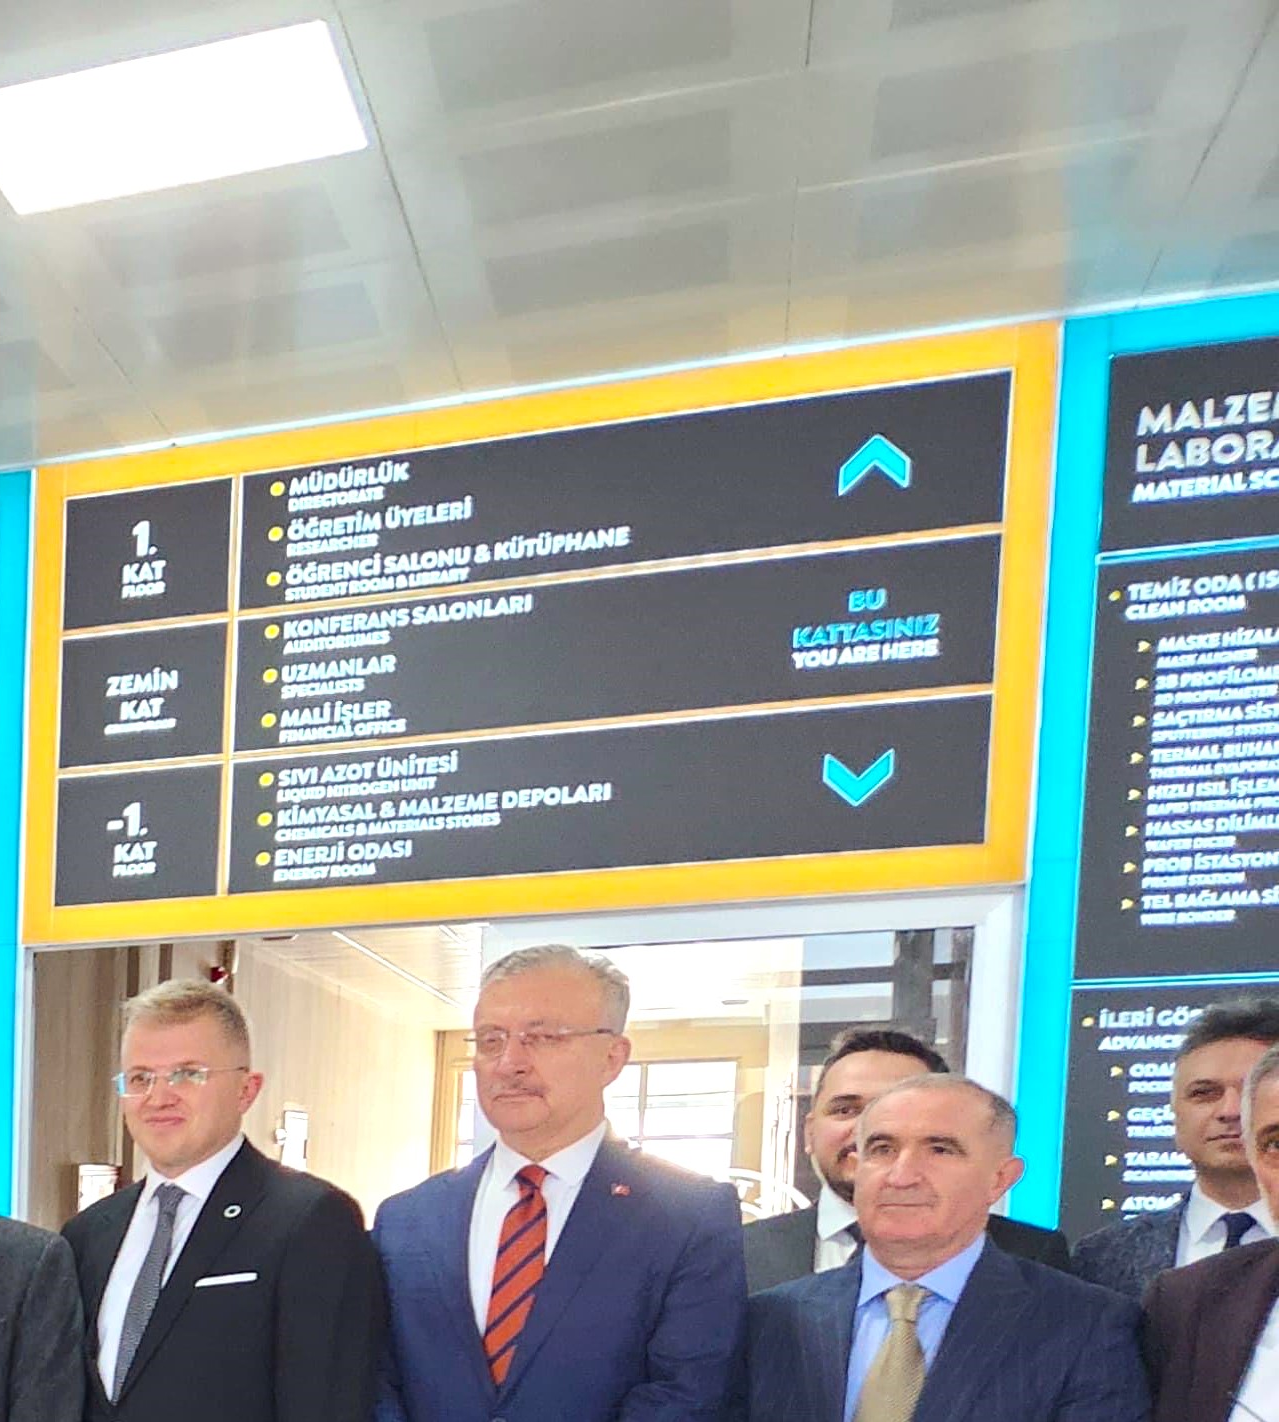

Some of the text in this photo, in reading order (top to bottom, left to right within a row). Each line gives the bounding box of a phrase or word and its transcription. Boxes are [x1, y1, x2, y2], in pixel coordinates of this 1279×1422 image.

[1136, 391, 1279, 436] MALZE
[288, 461, 410, 497] MÜDÜRLÜK
[1131, 471, 1247, 503] MATERIAL
[287, 486, 384, 511] DIRECTORATE
[287, 495, 472, 541] ÖĞRETİM ÜYELERİ
[131, 520, 158, 557] 1.
[285, 525, 630, 585] ÖĞRENCİ SALONU & KÜTÜPHANE
[121, 560, 166, 584] KAT
[285, 578, 349, 601] STUDENT
[349, 573, 394, 595] ROOM
[1127, 573, 1243, 600] TEMİZ ODA
[848, 588, 888, 613] BU
[1125, 595, 1246, 621] CLEAN ROOM
[283, 593, 534, 640] KONFERANS SALONLARI
[793, 613, 941, 648] KATTASINIZ
[281, 653, 397, 684] UZMANLAR
[791, 637, 940, 670] YOU ARE HERE
[105, 666, 179, 697] ZEMİN
[119, 697, 166, 721] KAT
[280, 699, 392, 729] MALİ İŞLER
[279, 718, 407, 744] FINANCIAL OFFICE
[277, 749, 459, 788] SIVI AZOT ÜNİTESİ
[276, 782, 612, 828] KİMYASAL & MALZEME DEPOLARI
[113, 841, 158, 864] KAT
[274, 839, 413, 867] ENERJİ ODASI
[1098, 1006, 1154, 1029] İLERİ
